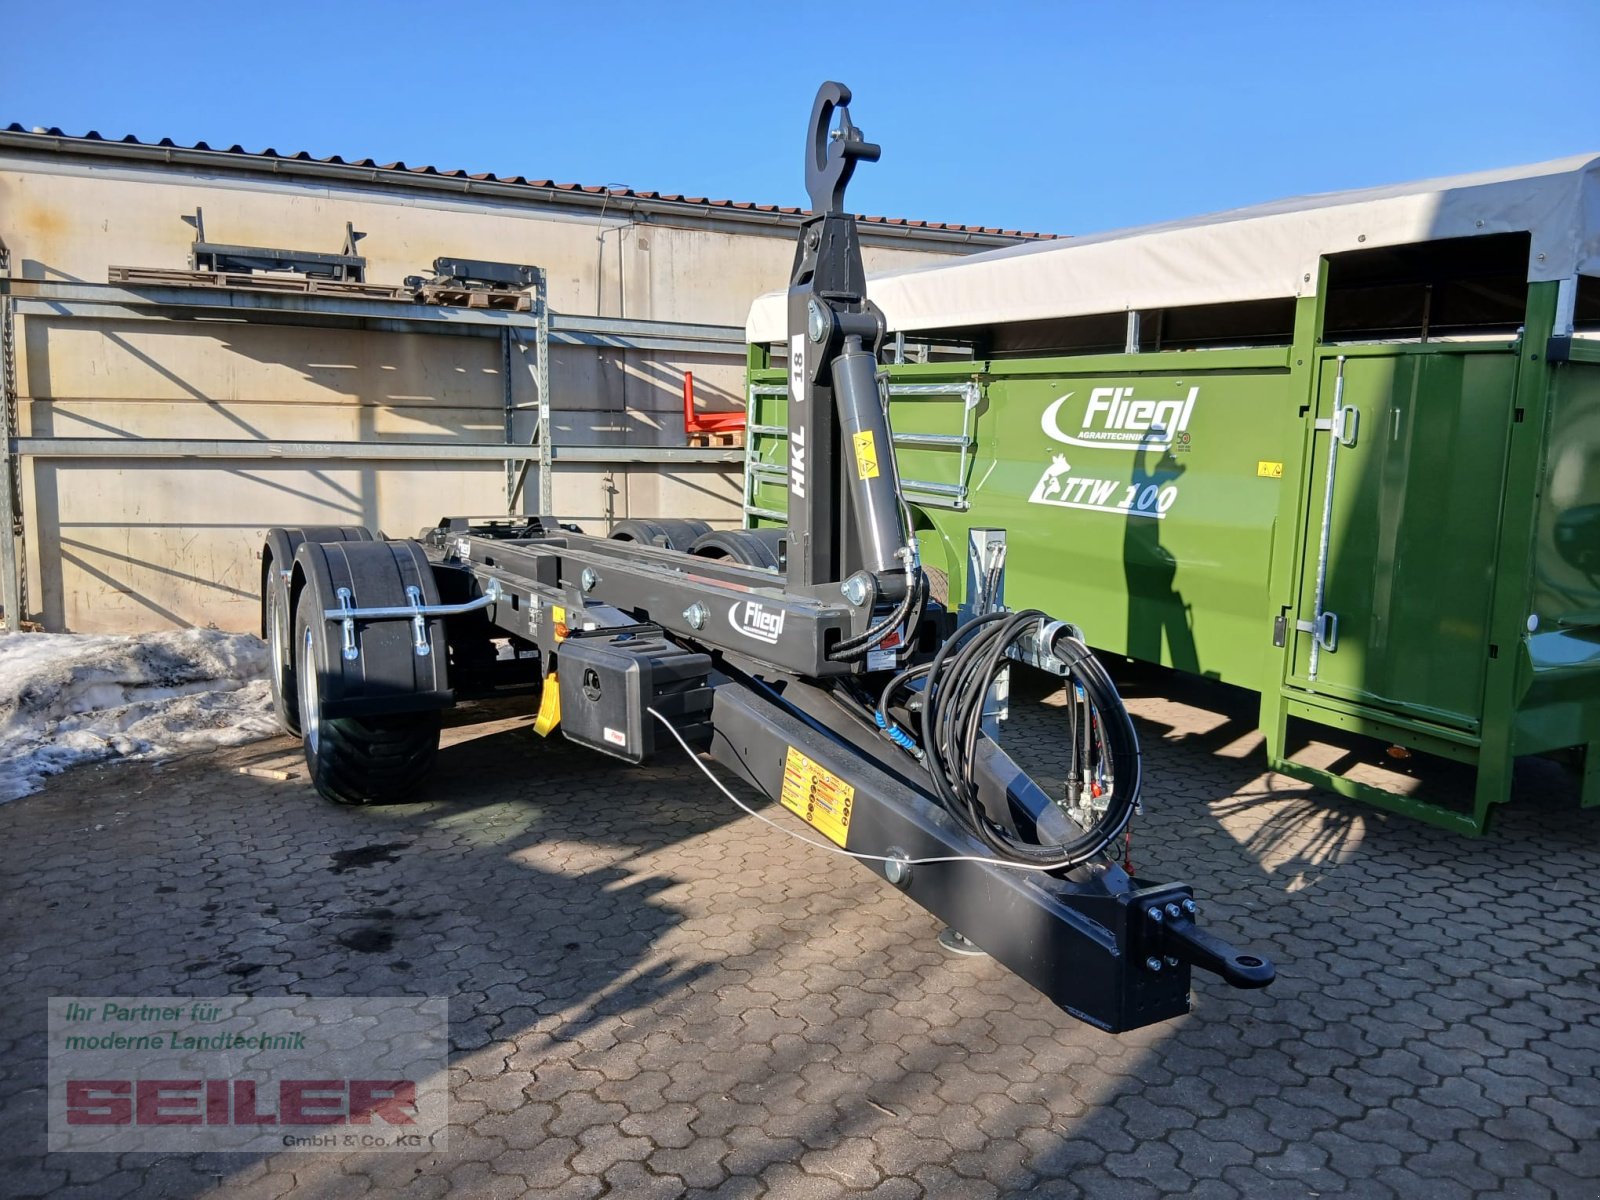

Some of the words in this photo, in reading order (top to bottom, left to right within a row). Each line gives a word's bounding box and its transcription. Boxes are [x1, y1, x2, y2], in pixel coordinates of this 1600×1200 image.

[793, 352, 803, 383] 18
[1081, 386, 1200, 443] Fliegl
[1077, 431, 1145, 441] AGRARTECHNIK
[791, 425, 805, 499] HKL
[1059, 477, 1121, 505] TTW
[1117, 483, 1178, 513] 100
[744, 601, 786, 640] Fliegl
